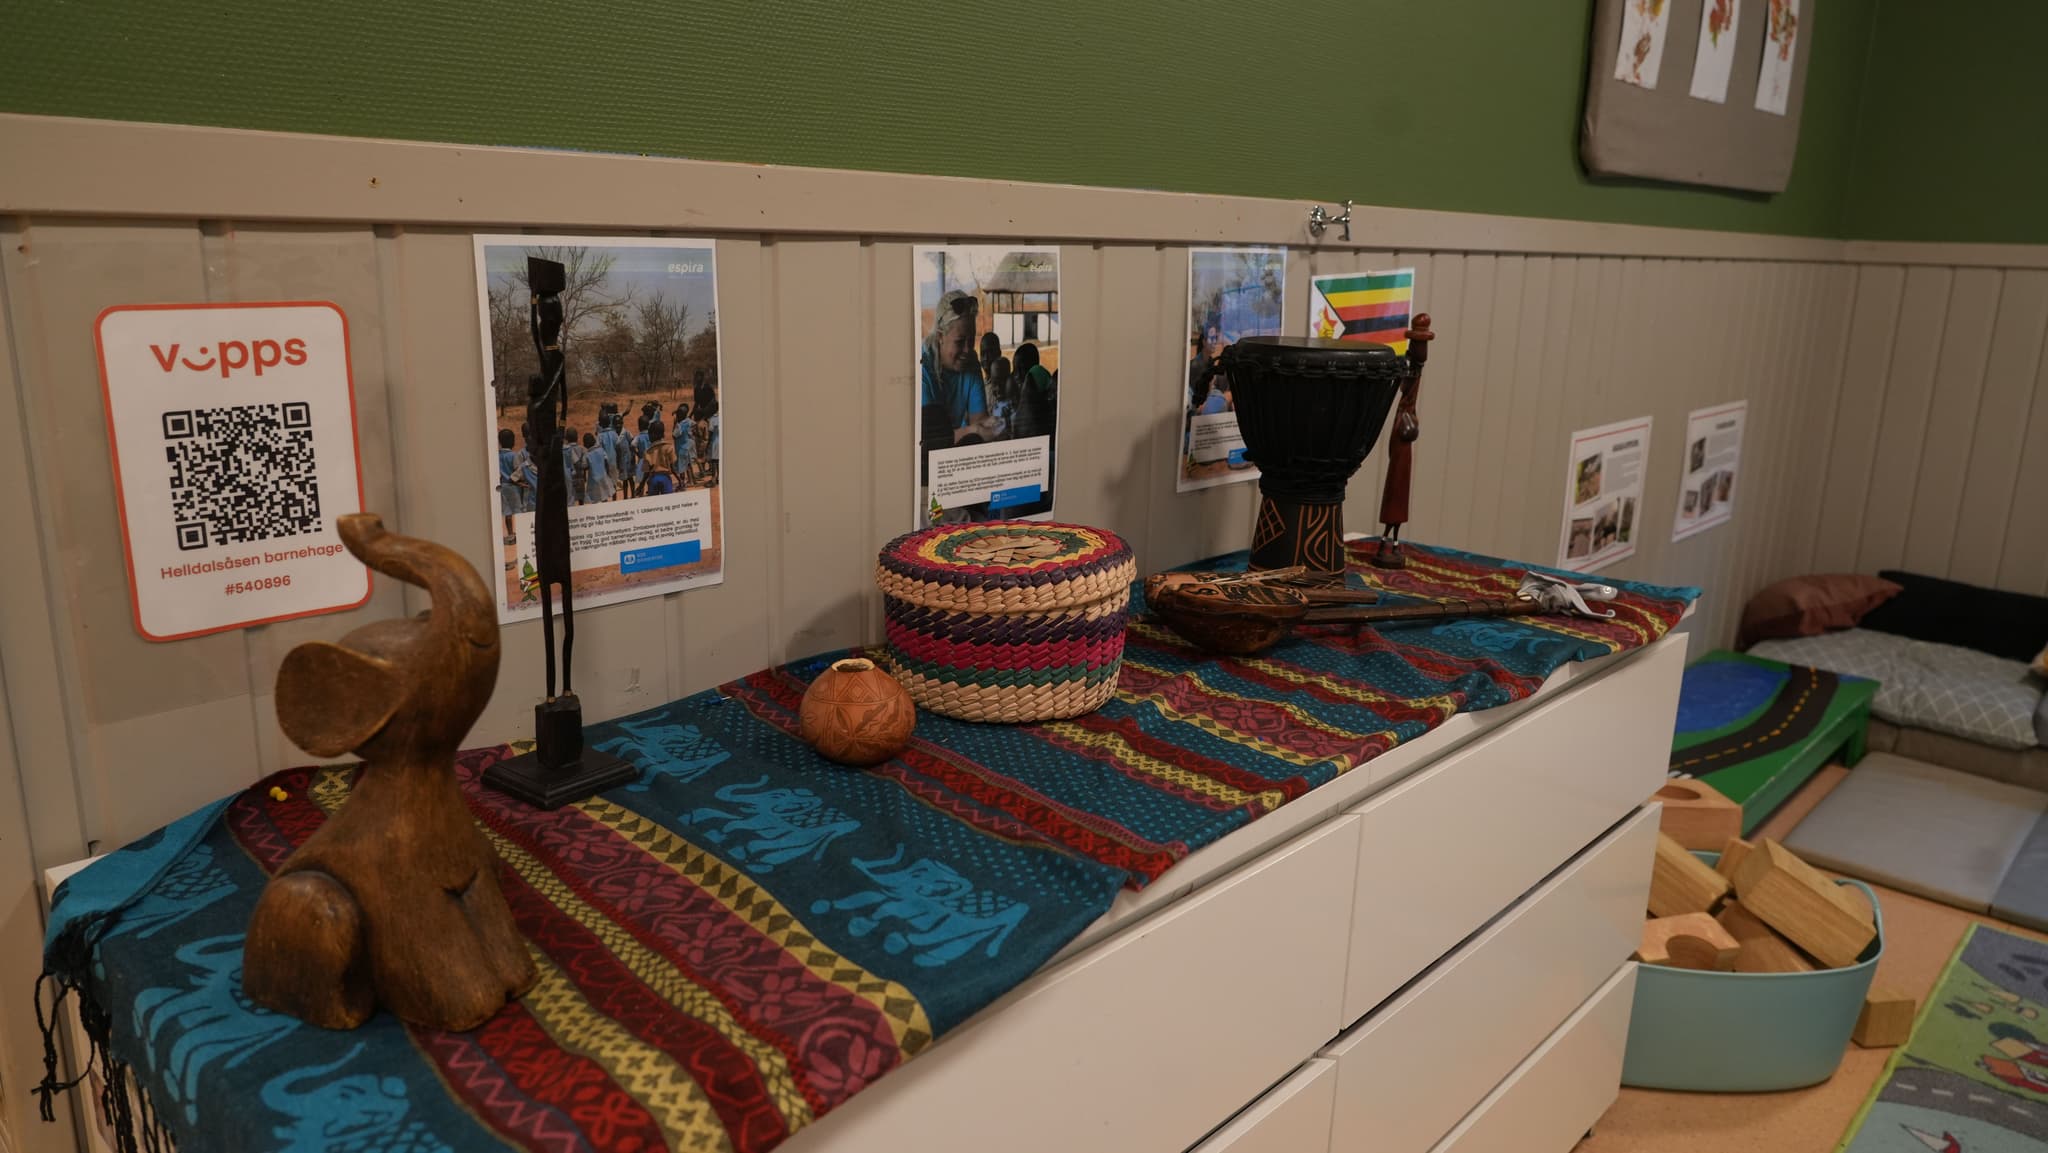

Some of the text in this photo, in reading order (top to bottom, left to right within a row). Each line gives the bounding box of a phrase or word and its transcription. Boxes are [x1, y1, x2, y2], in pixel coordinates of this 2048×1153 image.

[668, 260, 704, 275] espira
[161, 542, 344, 580] Helldalsåsen barnehage
[224, 575, 291, 596] #540896
